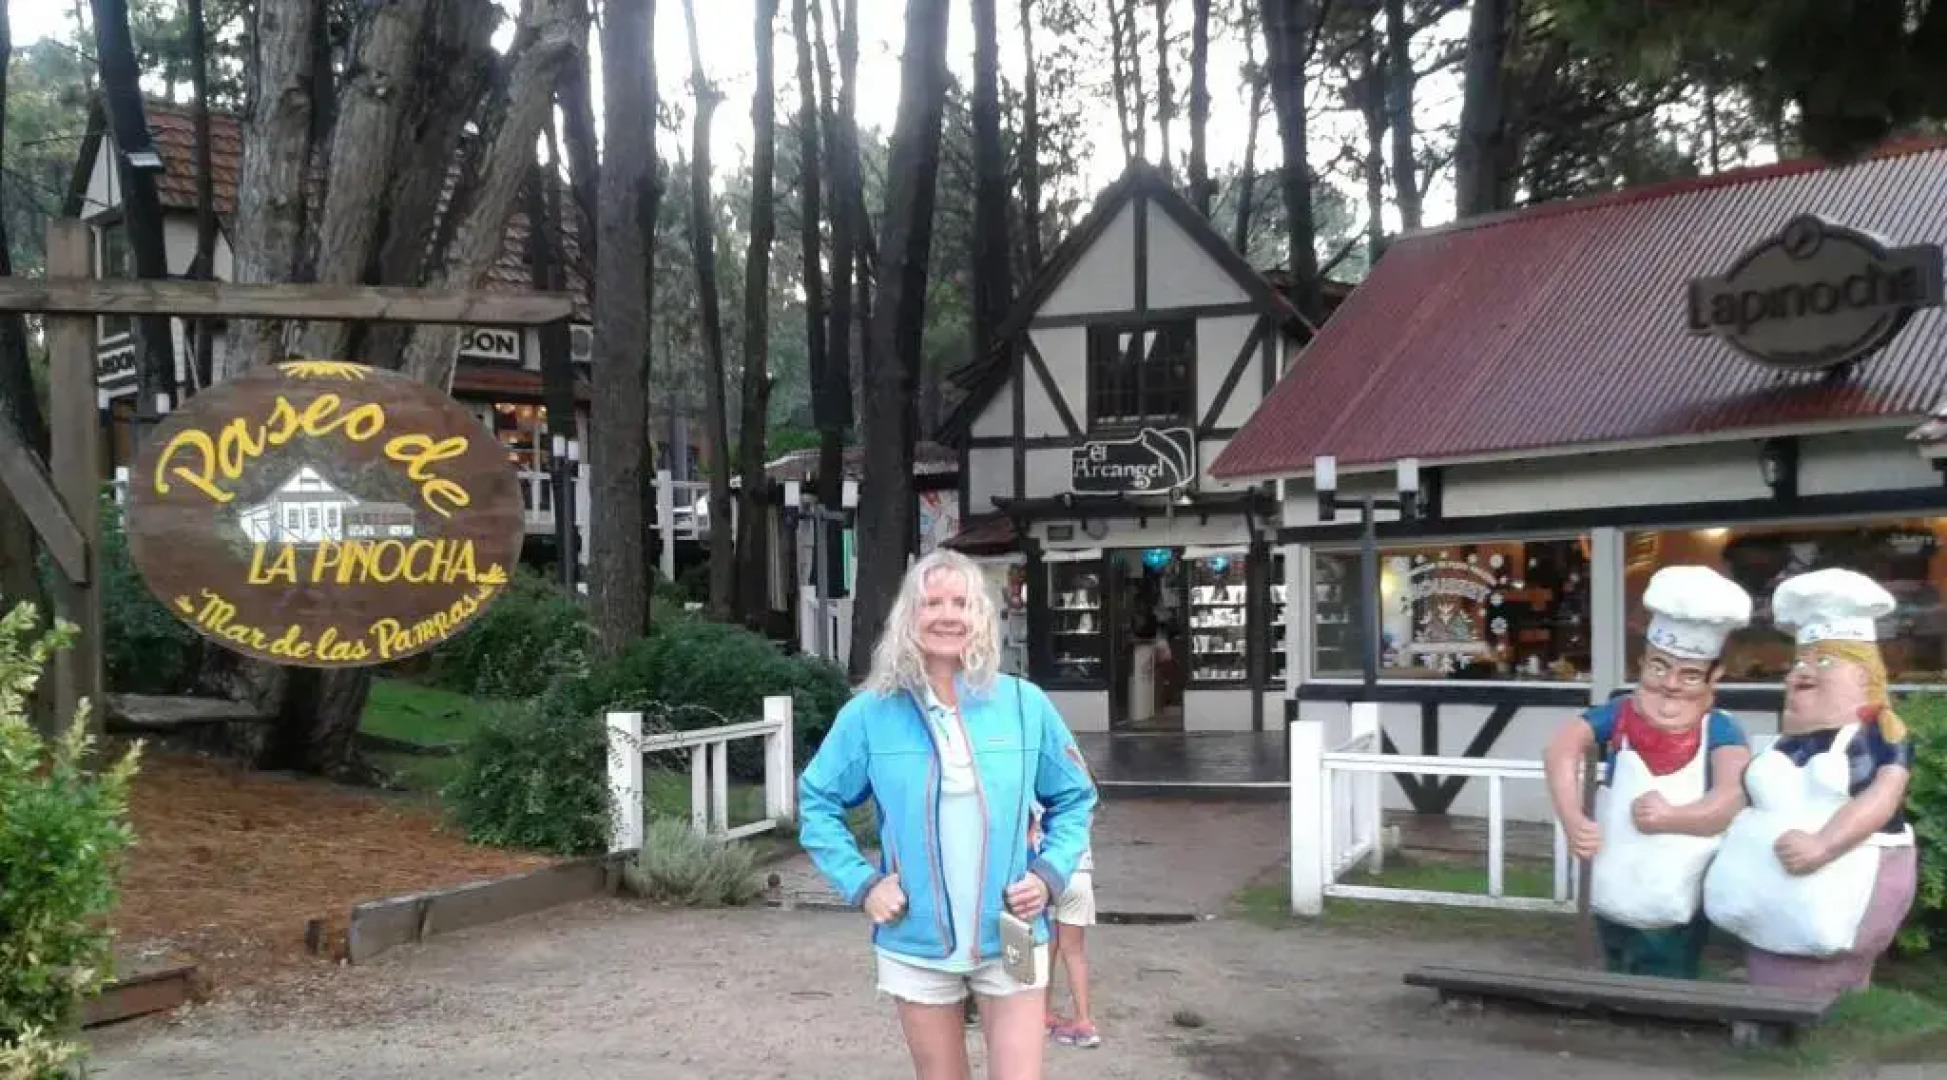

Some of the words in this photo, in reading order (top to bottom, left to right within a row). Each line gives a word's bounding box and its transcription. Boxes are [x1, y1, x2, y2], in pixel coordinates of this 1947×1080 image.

[156, 394, 384, 502] Paseo
[384, 434, 470, 518] de
[1073, 457, 1163, 488] Arcangel
[249, 540, 297, 584] LA
[312, 538, 476, 584] PINOCHA
[200, 589, 267, 649] Mar
[269, 625, 313, 658] de
[315, 628, 371, 661] las
[369, 592, 479, 660] Pampas
